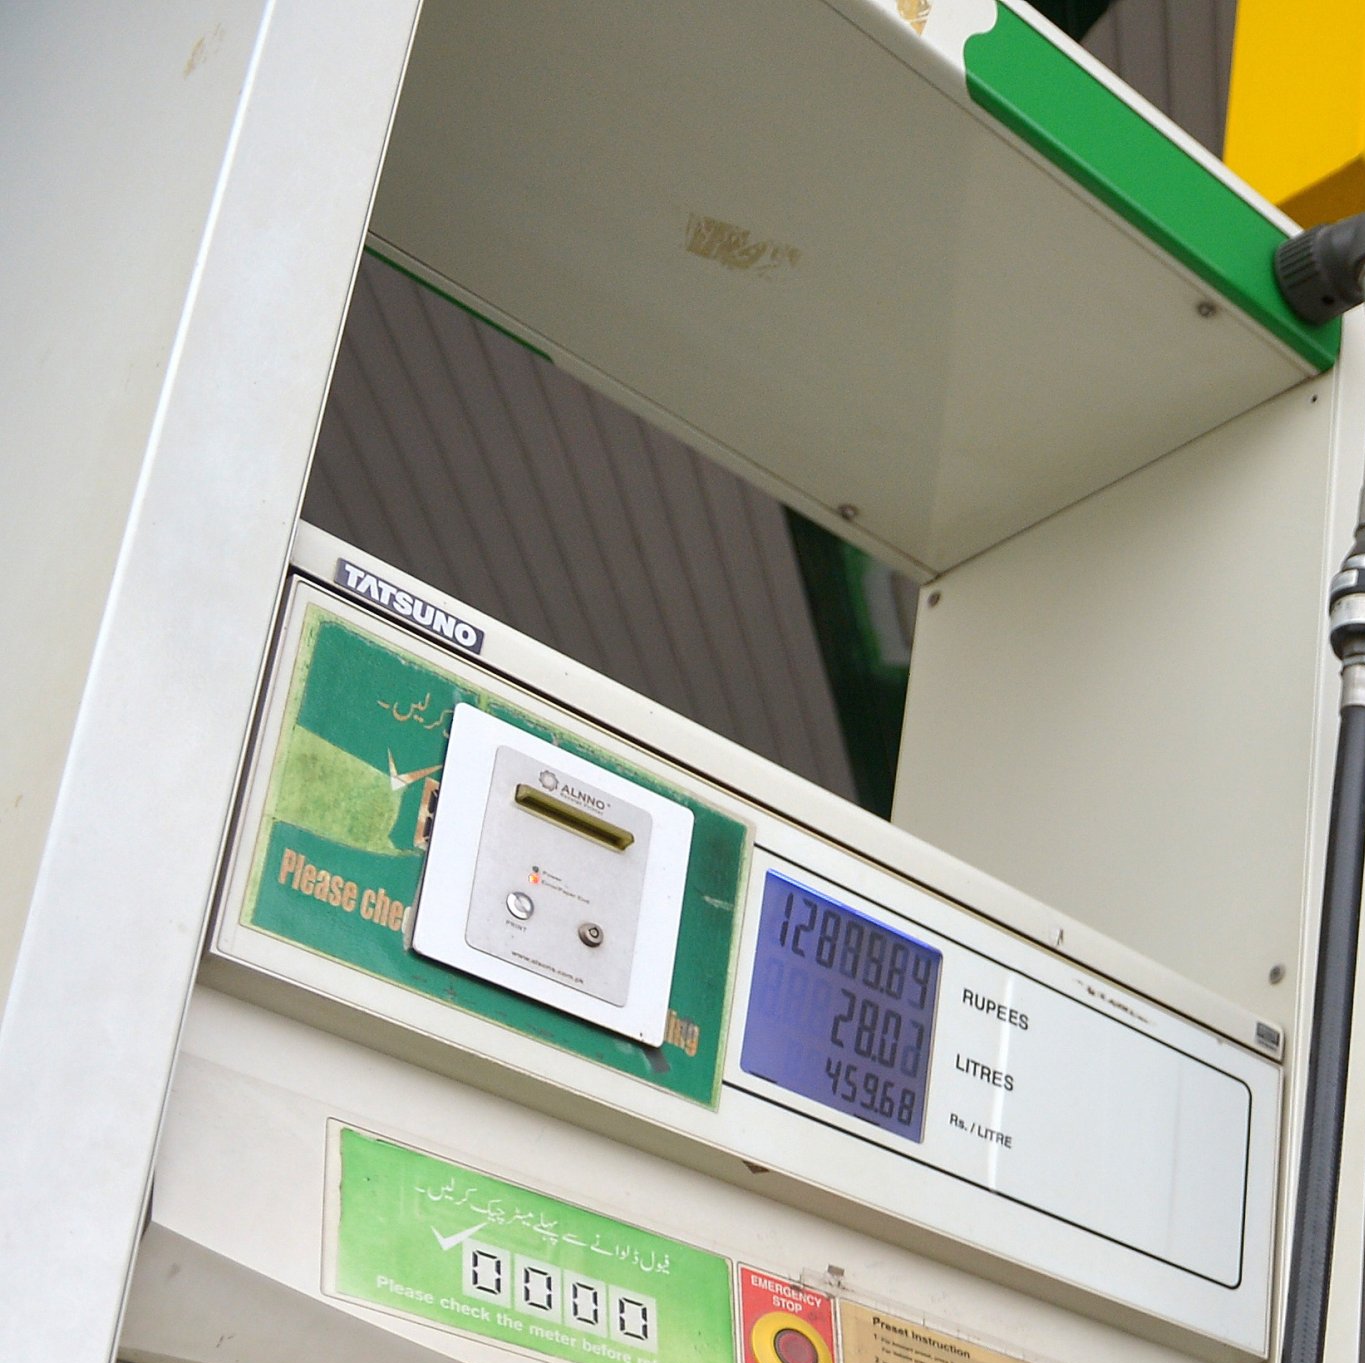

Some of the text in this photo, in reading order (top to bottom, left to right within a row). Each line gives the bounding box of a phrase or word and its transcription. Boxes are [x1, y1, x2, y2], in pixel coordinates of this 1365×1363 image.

[345, 563, 477, 647] TATSUNO
[279, 847, 358, 913] Please
[962, 988, 1029, 1031] RUPEES
[825, 1057, 916, 1127] 459.68
[955, 1053, 1014, 1092] LITRES
[949, 1112, 968, 1131] Rs.
[977, 1124, 1012, 1149] LITRE
[376, 1275, 433, 1304] Please
[440, 1297, 490, 1322] check
[496, 1313, 523, 1331] the
[529, 1324, 577, 1348] meter
[751, 1274, 822, 1308] EMERGENCY
[772, 1295, 803, 1314] STOP
[872, 1316, 908, 1338] Preset
[911, 1330, 971, 1360] Instruction
